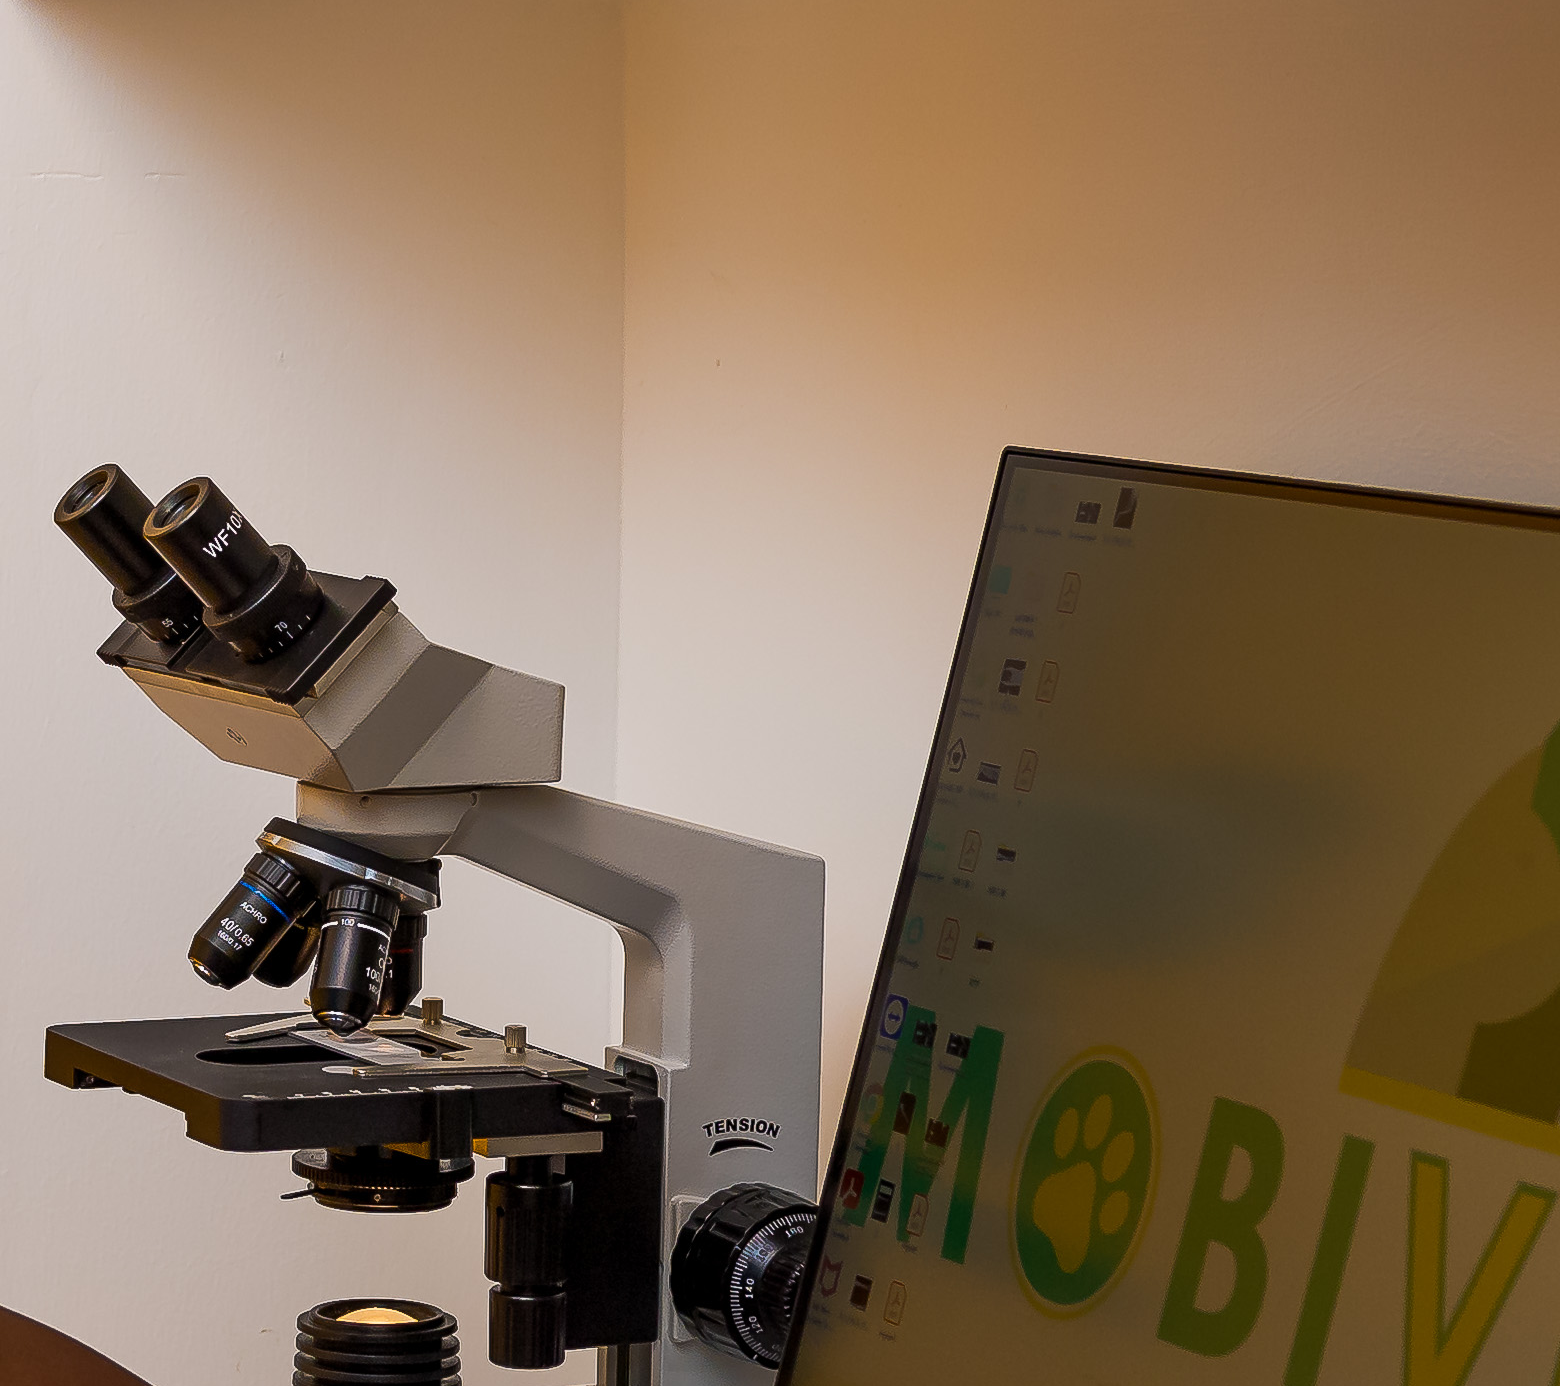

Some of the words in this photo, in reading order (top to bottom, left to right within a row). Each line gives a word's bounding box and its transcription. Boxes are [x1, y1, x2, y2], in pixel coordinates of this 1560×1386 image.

[274, 620, 288, 632] 70
[240, 901, 267, 924] ACHRO
[220, 917, 255, 947] 40/0.65
[702, 1117, 782, 1139] TENSION
[744, 1278, 755, 1299] 140
[748, 1315, 764, 1334] 120
